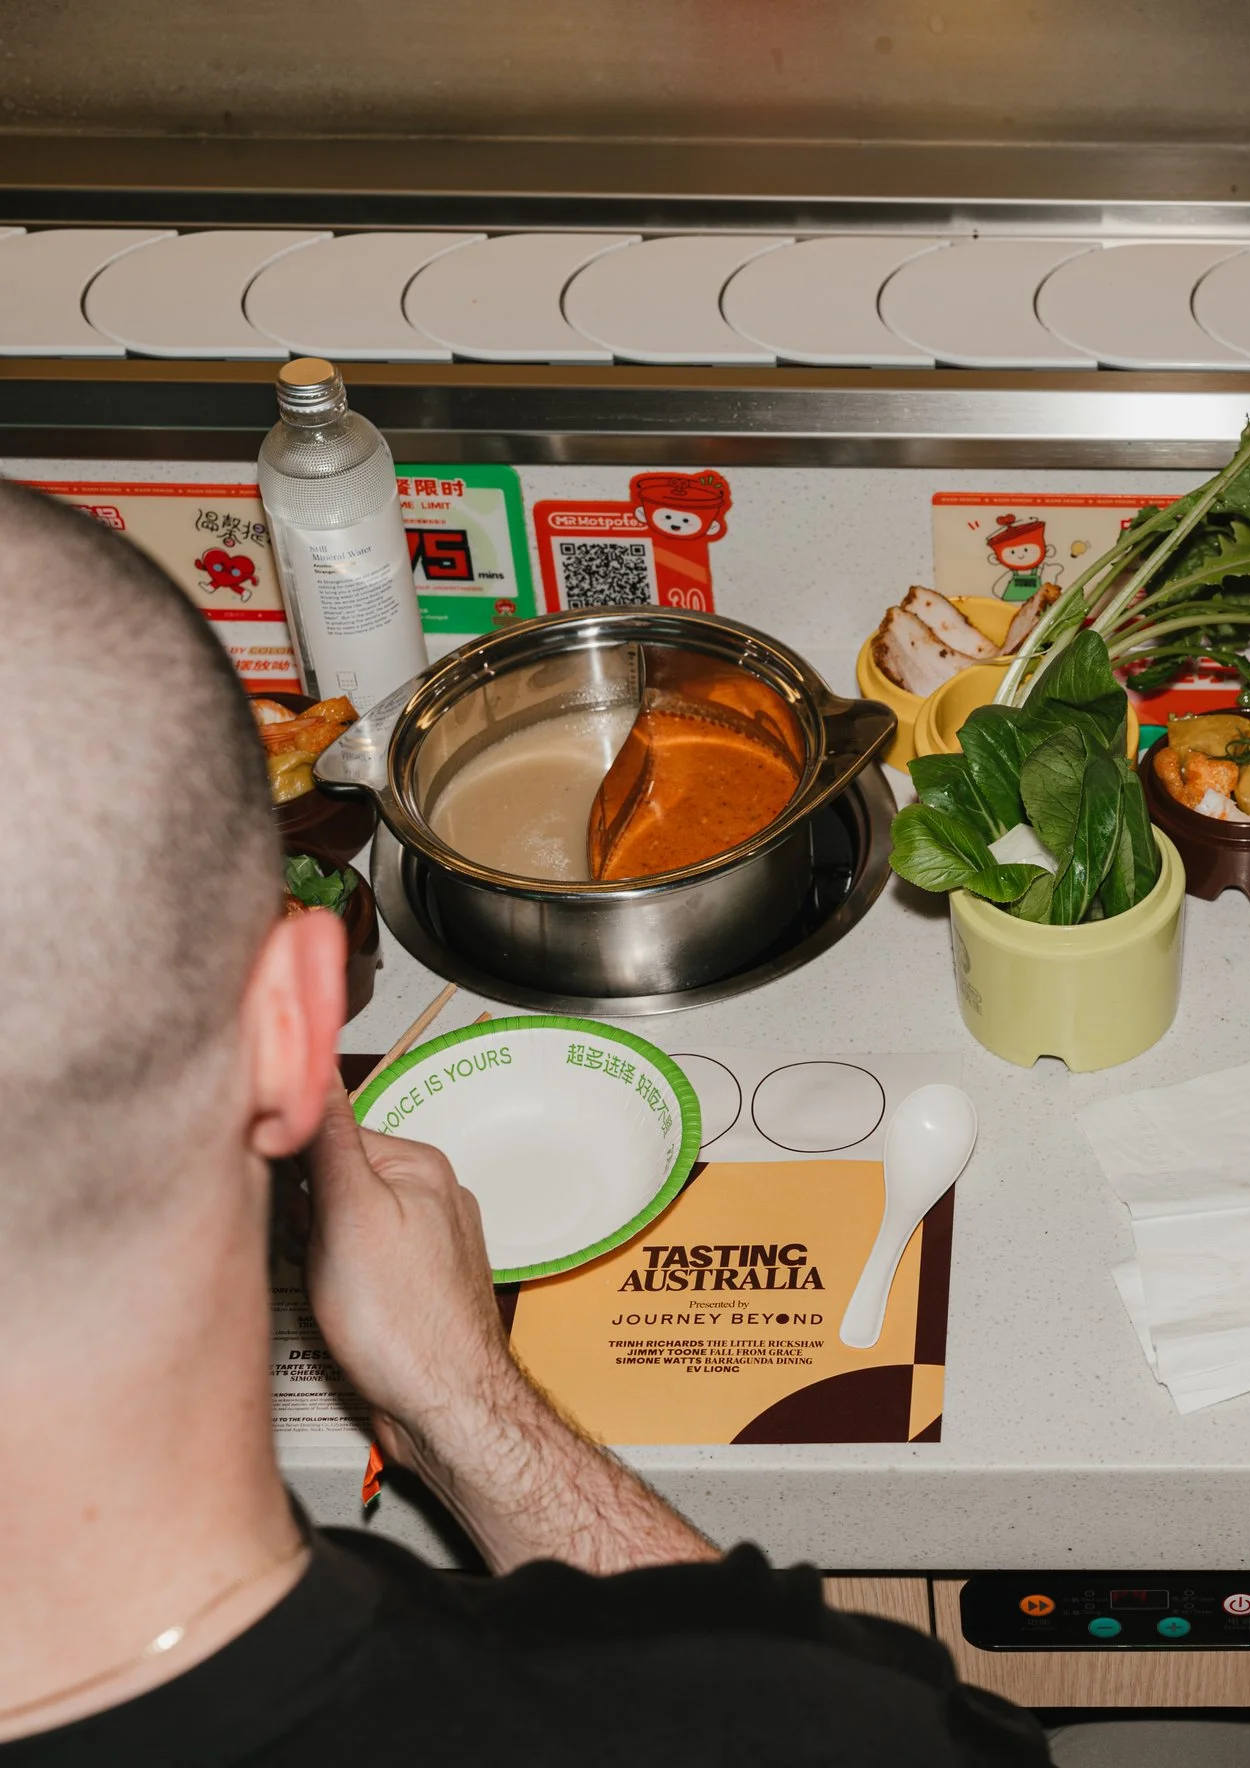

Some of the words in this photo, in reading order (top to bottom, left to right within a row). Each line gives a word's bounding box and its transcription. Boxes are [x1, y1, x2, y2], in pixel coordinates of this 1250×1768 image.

[396, 478, 464, 497] 餐限时
[400, 501, 414, 509] ME
[421, 502, 451, 510] LIMIT
[195, 508, 271, 548] 温馨提
[347, 546, 372, 558] Water
[478, 571, 505, 580] mins
[668, 588, 705, 612] 30
[566, 1043, 636, 1085] 超多选择
[380, 1088, 425, 1137] HOICE
[424, 1073, 443, 1095] IS
[443, 1046, 512, 1083] YOURS
[642, 1243, 809, 1269] TASTING
[617, 1266, 826, 1292] AUSTRALIA
[689, 1300, 736, 1309] Presented
[737, 1300, 750, 1311] by
[612, 1313, 722, 1326] JOURNEY
[731, 1313, 823, 1325] BEYOND
[608, 1340, 644, 1348] TRINH
[645, 1340, 705, 1348] RICHARDS
[706, 1340, 728, 1348] THE
[729, 1340, 766, 1348] LITTLE
[768, 1340, 825, 1348] RICKSHAW
[288, 1350, 331, 1360] DESS
[627, 1348, 665, 1357] JIMMY
[667, 1348, 708, 1357] TOONE
[709, 1348, 735, 1357] FALL
[736, 1348, 766, 1357] FROM
[768, 1348, 803, 1357] GRACE
[615, 1357, 661, 1365] SIMONE
[663, 1357, 703, 1365] WATTS
[704, 1357, 775, 1365] BARRAGUNDA
[776, 1357, 813, 1365] DINING
[686, 1365, 701, 1373] EV
[703, 1365, 740, 1373] LIONG
